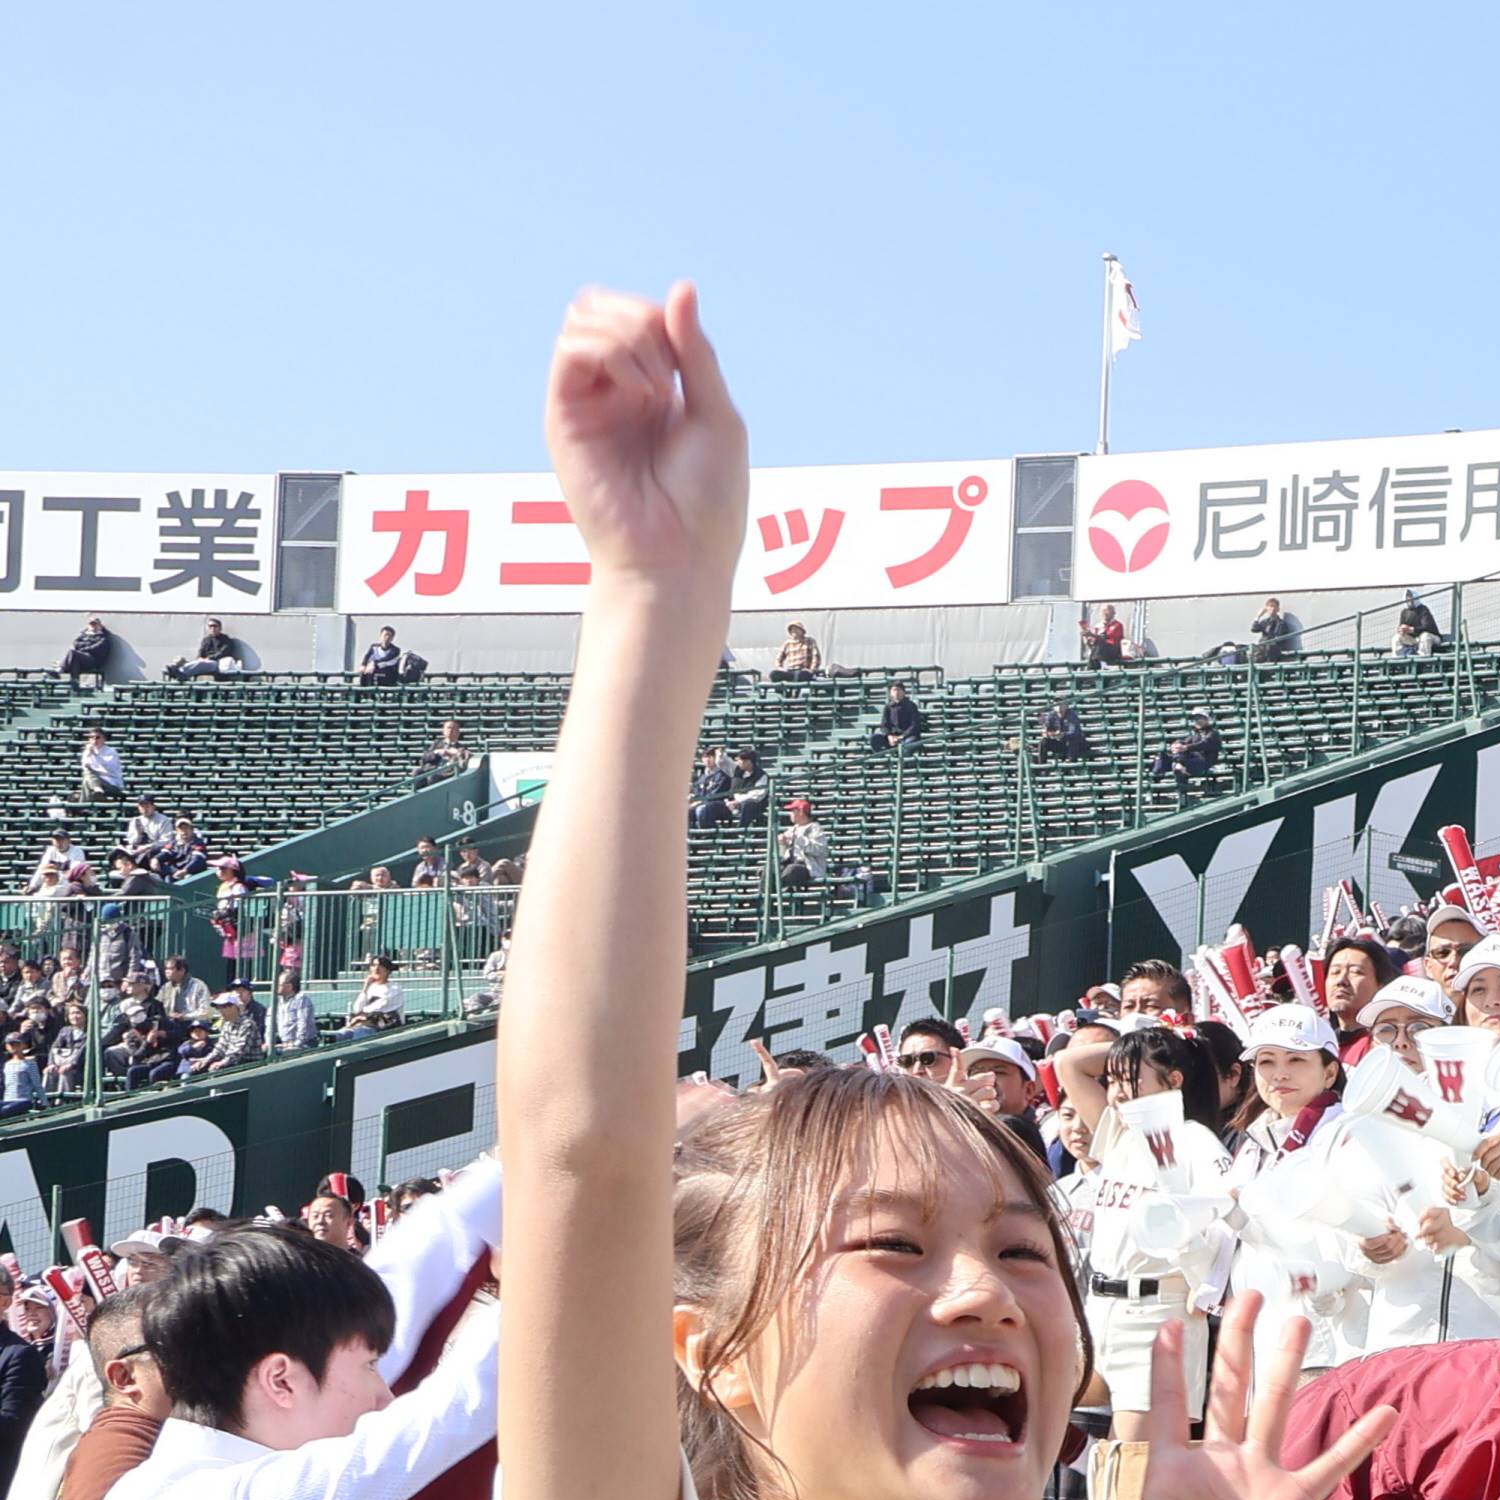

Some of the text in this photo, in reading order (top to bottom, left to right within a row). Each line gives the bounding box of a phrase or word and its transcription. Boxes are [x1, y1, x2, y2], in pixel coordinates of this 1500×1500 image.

[0, 488, 264, 598] 工業
[364, 474, 988, 597] カニップ
[1434, 1059, 1466, 1103] W
[1143, 1125, 1178, 1169] W
